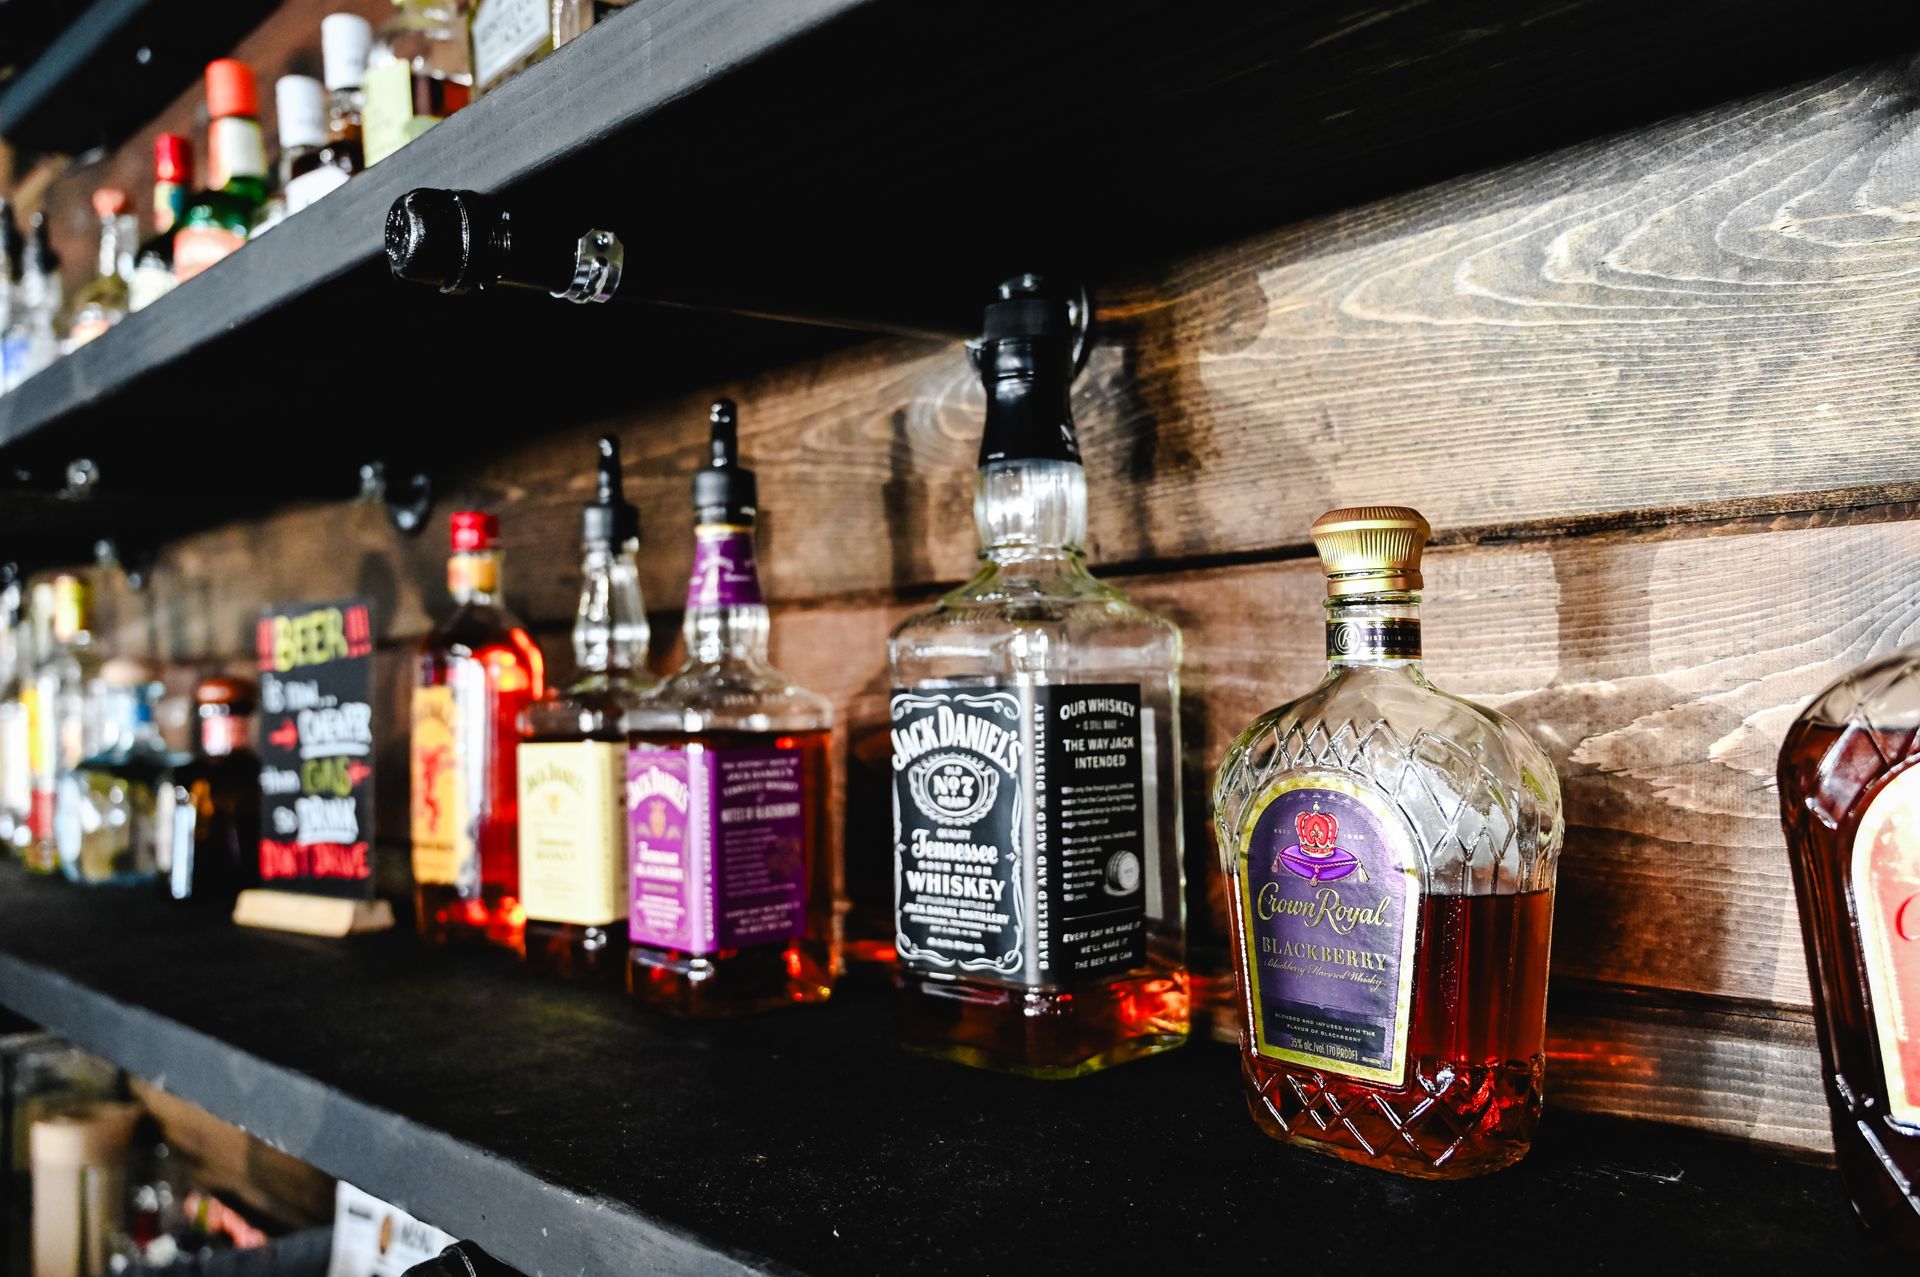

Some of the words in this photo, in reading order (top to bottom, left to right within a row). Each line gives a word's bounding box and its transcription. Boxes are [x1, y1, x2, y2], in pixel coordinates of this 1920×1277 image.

[1060, 700, 1086, 720] OUR
[1087, 698, 1135, 718] WHISKEY
[890, 715, 940, 771] JACK
[937, 705, 1024, 775] DANIEL'S
[1034, 703, 1046, 790] DISTILLERY
[1062, 738, 1086, 752] THE
[1087, 737, 1109, 750] WAY
[1109, 736, 1134, 750] JACK
[943, 765, 963, 776] OLD
[1075, 753, 1126, 769] INTENDED
[1036, 812, 1047, 852] AGED
[911, 828, 999, 865] Tennessee
[917, 860, 951, 873] SOUR
[954, 863, 992, 877] MASH
[1036, 855, 1047, 887] AND
[906, 870, 1006, 902] WHISKEY
[1257, 882, 1317, 921] Crown
[1304, 887, 1391, 935] Royal
[1037, 890, 1049, 970] BARRELED
[1062, 932, 1088, 943] EVERY
[1089, 929, 1103, 938] DAY
[1075, 960, 1088, 970] THE
[1090, 955, 1107, 967] BEST
[1262, 936, 1388, 971] BLACKBERRY
[1263, 957, 1306, 979] Blackberry
[1307, 963, 1348, 980] Flavored
[1347, 969, 1388, 992] Whisky
[1275, 1012, 1301, 1022] BLENDED
[1315, 1021, 1343, 1031] INFUSED
[1286, 1023, 1309, 1032] FLAVOR
[1320, 1030, 1361, 1042] BLACKBERRY
[1290, 1037, 1303, 1049] 35%
